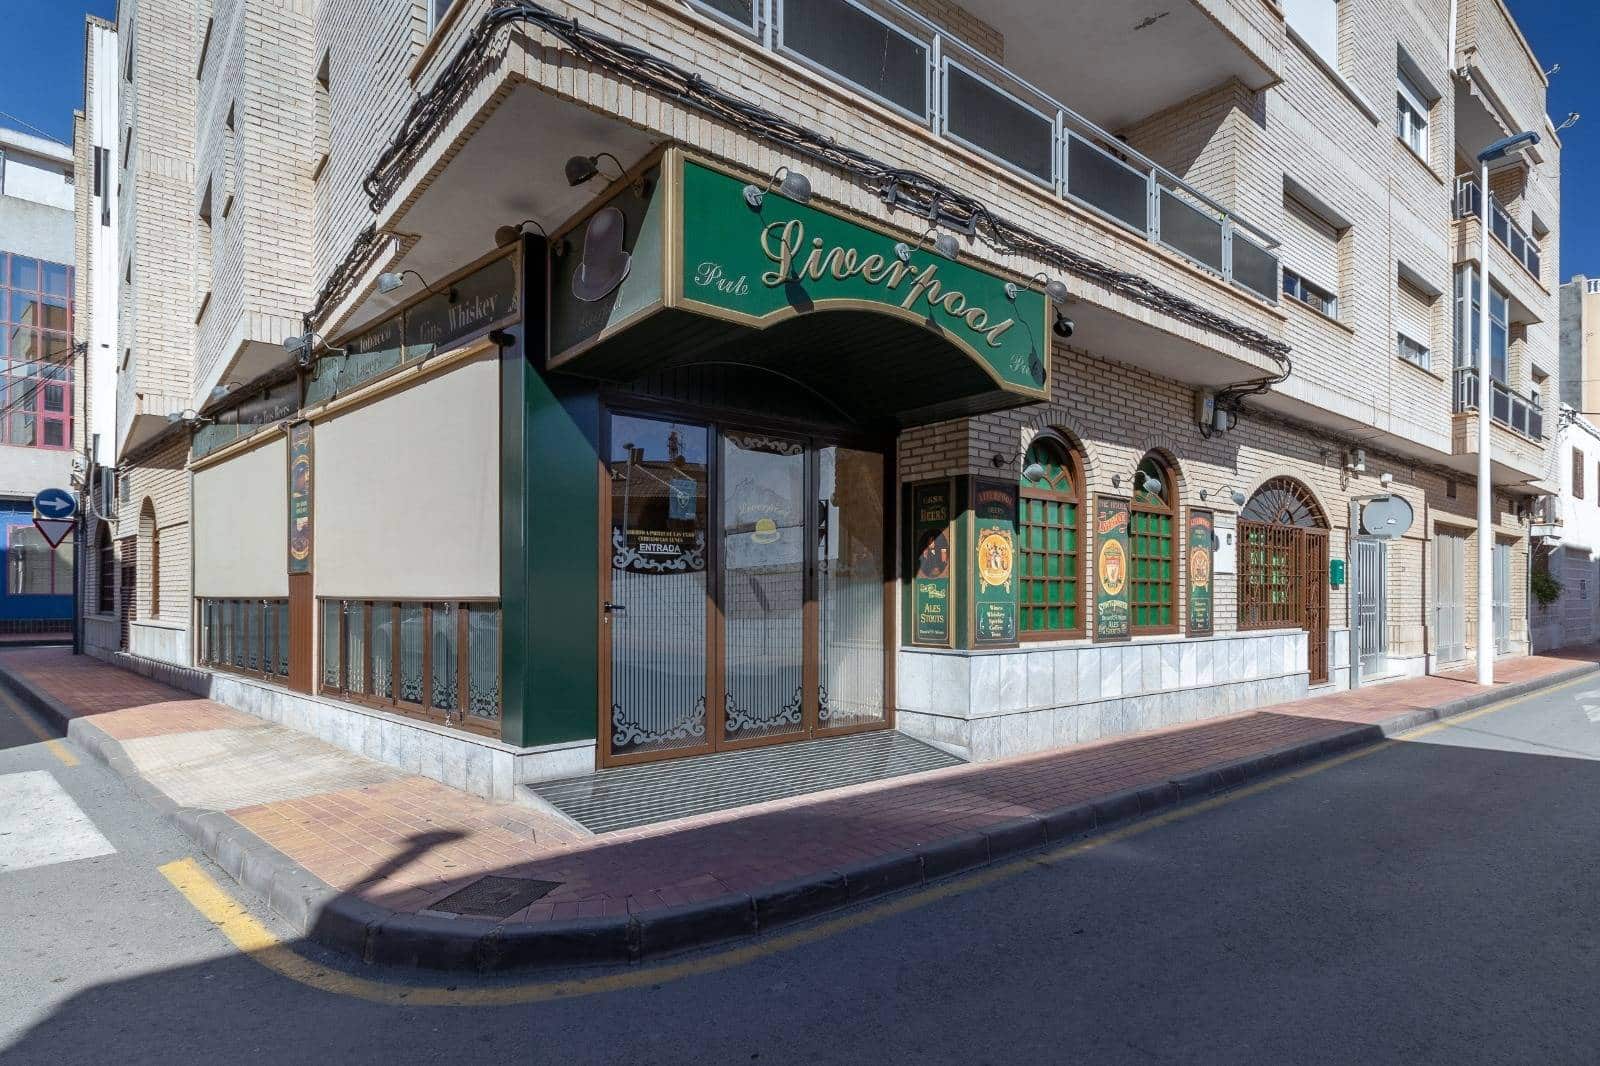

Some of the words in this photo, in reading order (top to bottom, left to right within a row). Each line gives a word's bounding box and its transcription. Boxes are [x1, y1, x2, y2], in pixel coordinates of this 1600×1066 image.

[694, 262, 749, 296] Pub
[760, 219, 1014, 347] Liverpool
[639, 543, 681, 553] ENTRADA
